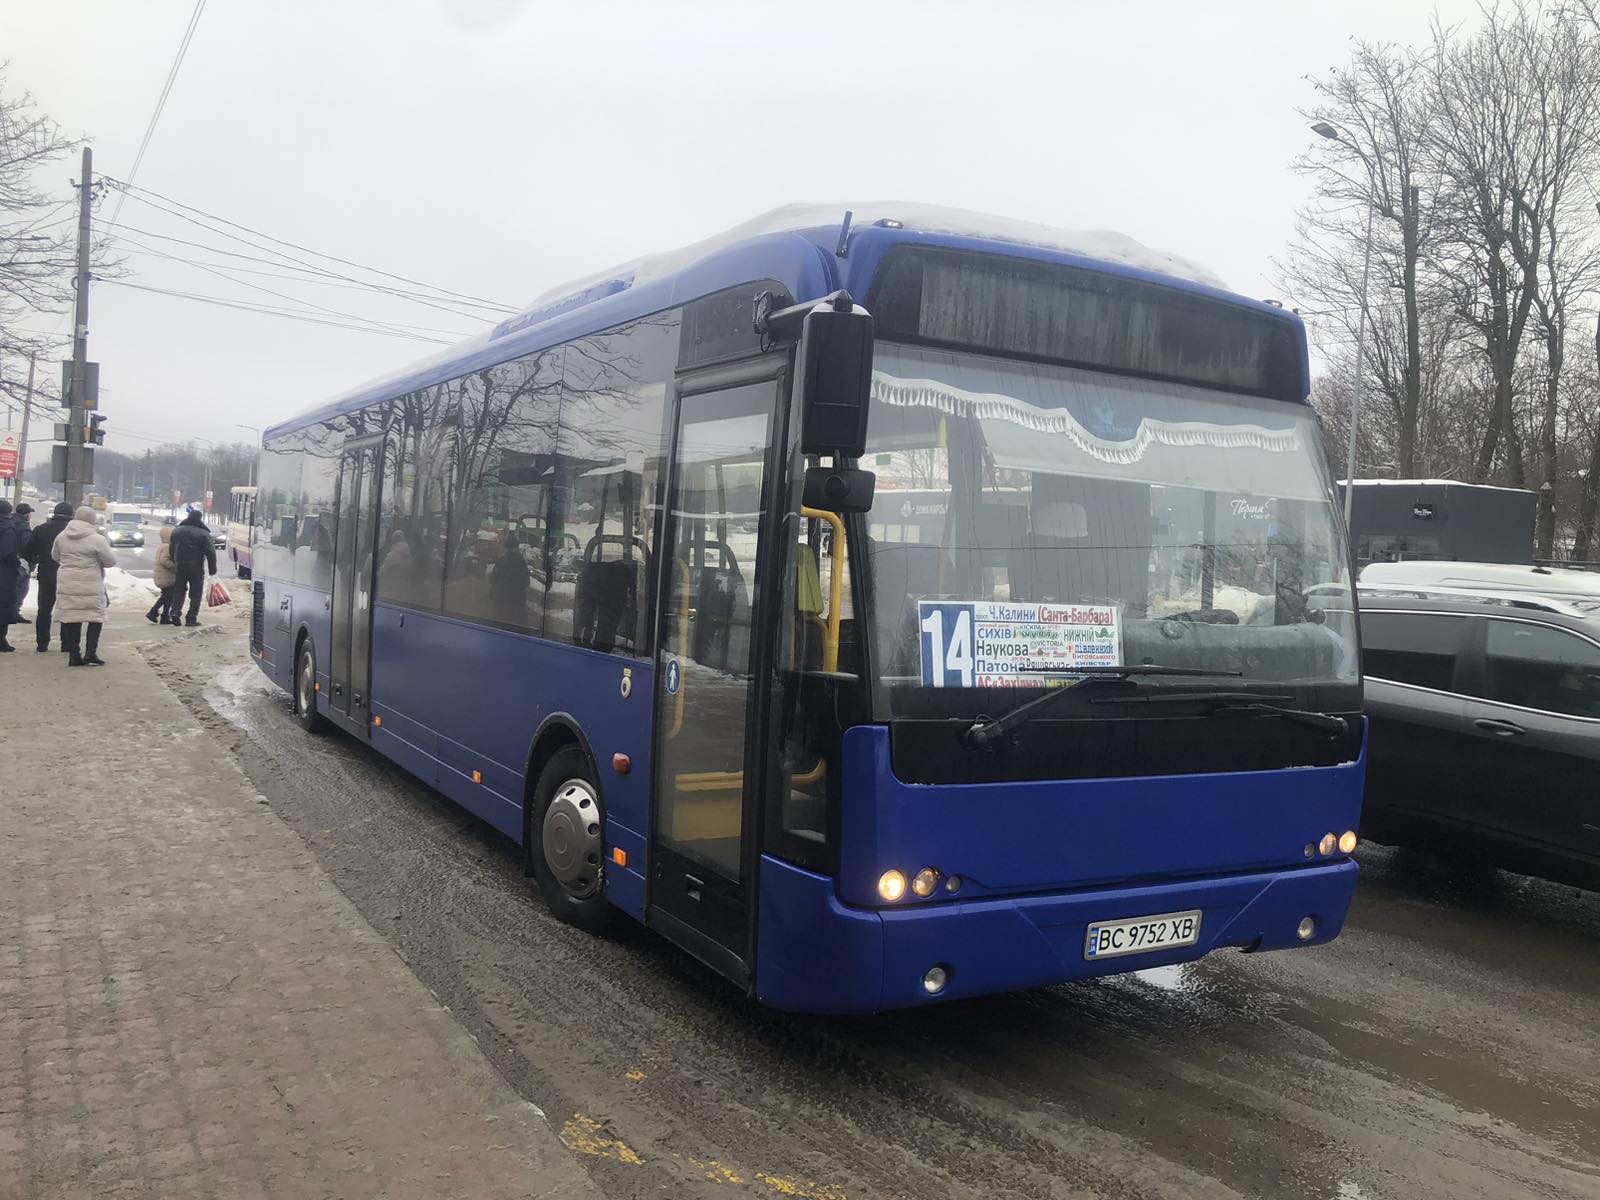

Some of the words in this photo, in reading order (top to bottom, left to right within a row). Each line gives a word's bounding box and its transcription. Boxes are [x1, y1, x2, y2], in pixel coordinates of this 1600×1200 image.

[989, 605, 1036, 621] Ч.Калини
[1038, 605, 1113, 625] (Санта-Барбара)
[978, 628, 1011, 639] СИХІВ
[1063, 627, 1095, 642] НИЖНІЙ
[922, 610, 974, 687] 14
[976, 640, 1029, 659] Наукова
[1098, 928, 1124, 951] BC
[1128, 922, 1167, 947] 9752
[1170, 918, 1194, 941] XB
